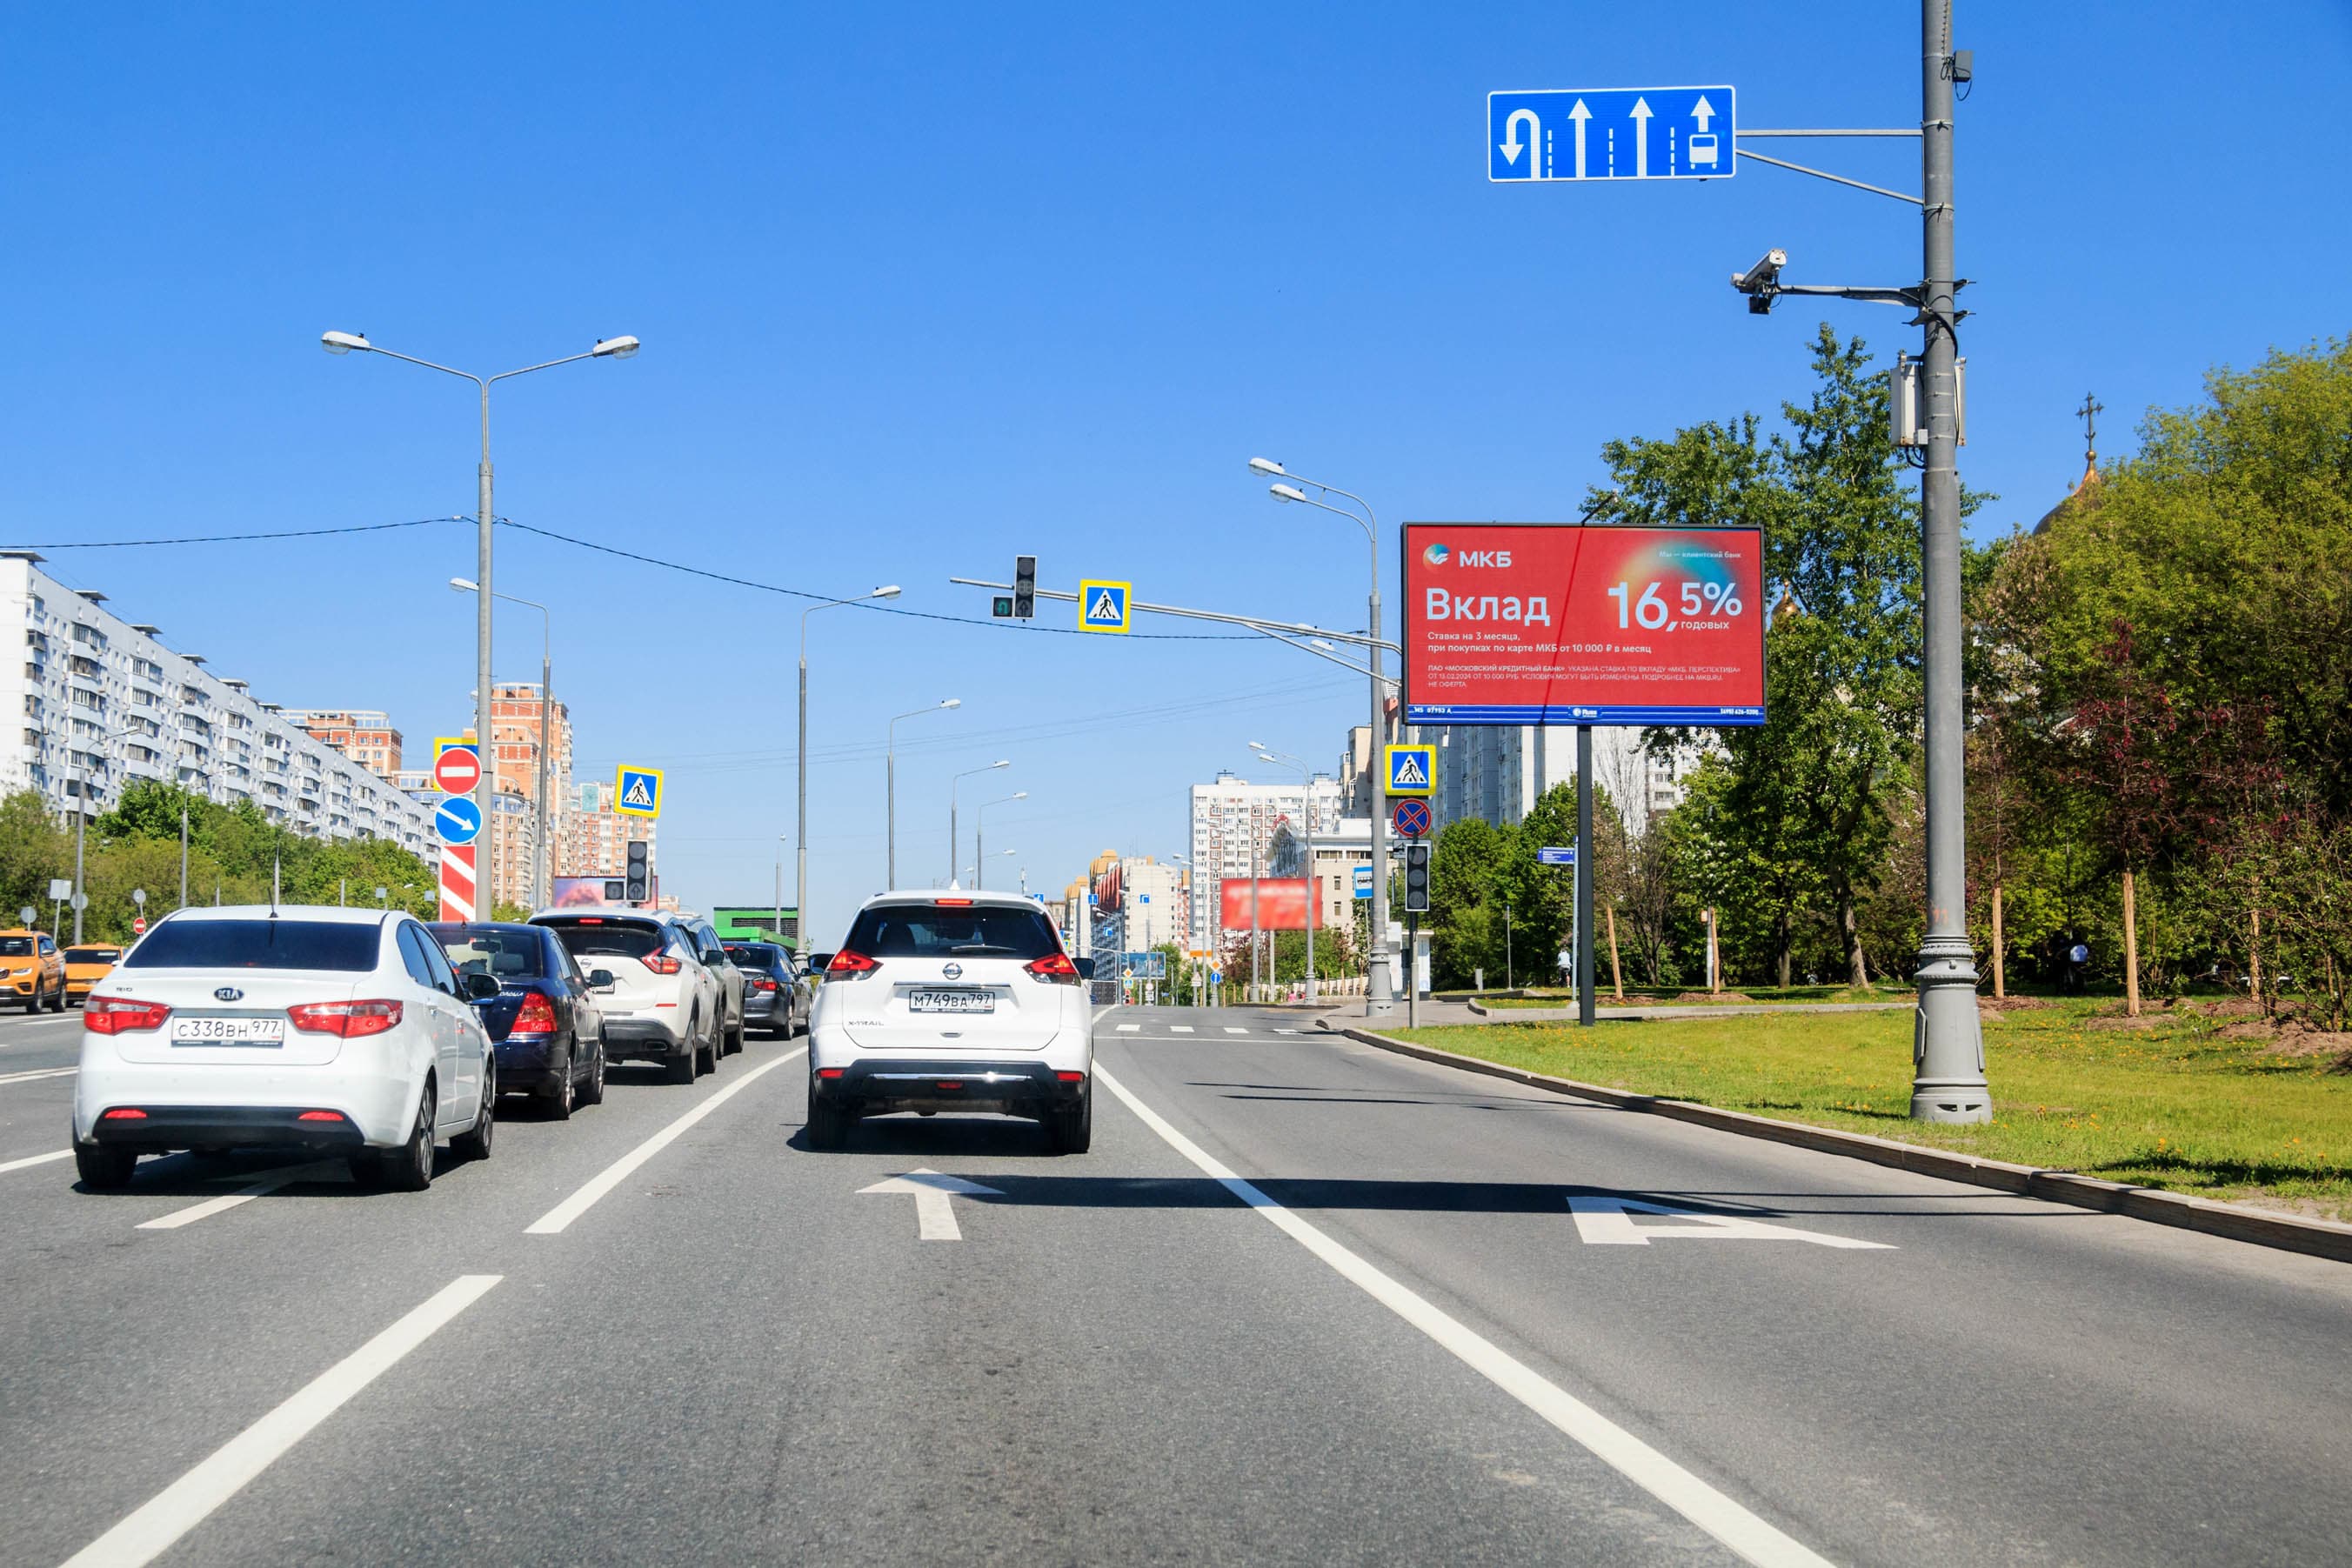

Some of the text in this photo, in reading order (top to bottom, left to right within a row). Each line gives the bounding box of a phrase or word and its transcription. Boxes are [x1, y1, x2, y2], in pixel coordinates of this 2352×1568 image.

[1459, 550, 1513, 568] МКБ
[1427, 587, 1551, 626] Вклад
[1680, 621, 1730, 631] годовых
[1427, 631, 1460, 640] Ставка
[1476, 631, 1482, 640] 3
[1484, 633, 1520, 642] месяца,
[1427, 644, 1446, 654] при
[1447, 644, 1491, 654] покупках
[1507, 645, 1533, 654] карте
[1535, 644, 1558, 653] МКБ
[1572, 644, 1583, 652] 10
[1585, 644, 1603, 652] 000
[1444, 664, 1497, 672] «МОСКОВСКИЙ
[217, 989, 240, 999] KIA
[969, 994, 990, 1004] 797
[252, 1020, 278, 1033] 977
